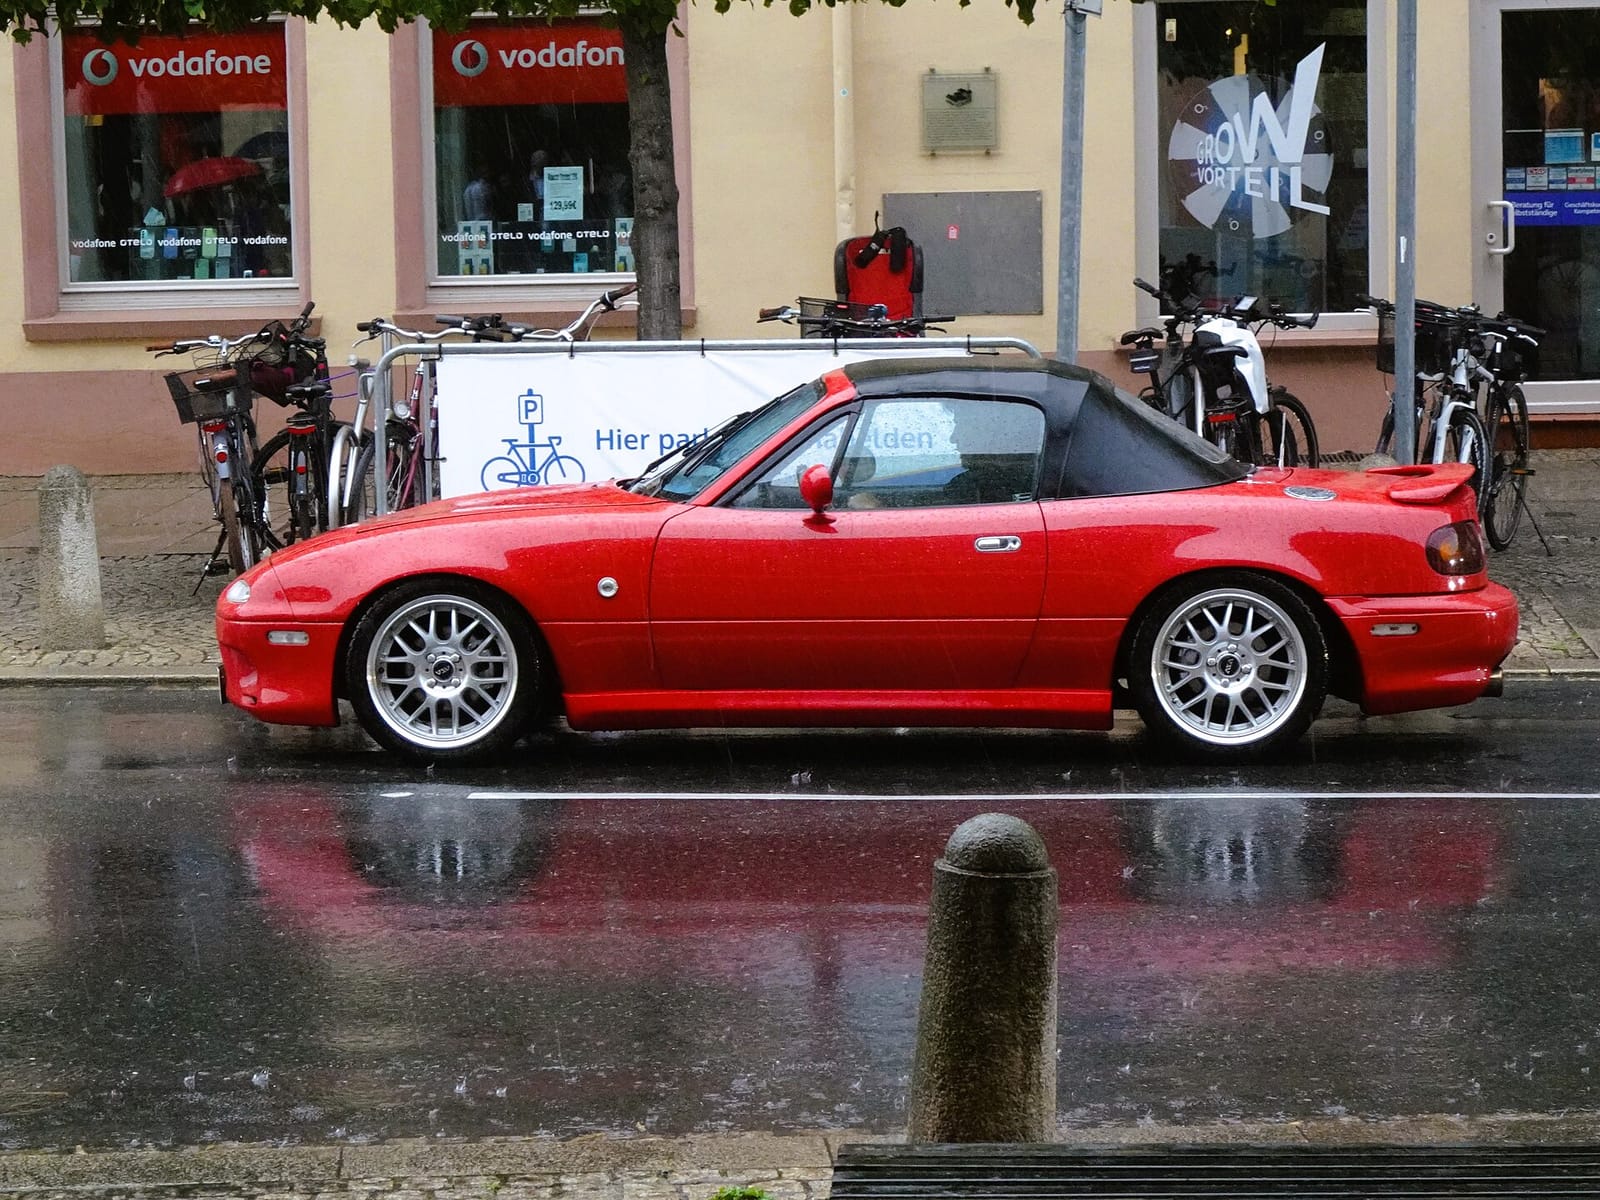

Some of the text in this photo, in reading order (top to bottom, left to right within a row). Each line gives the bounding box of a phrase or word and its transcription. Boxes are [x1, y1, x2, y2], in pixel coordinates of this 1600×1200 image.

[128, 49, 272, 78] vodafone
[498, 40, 625, 69] vodafon
[1196, 41, 1327, 165] GROW
[1196, 166, 1331, 216] VORTEIL
[1544, 200, 1554, 208] für
[72, 238, 117, 248] vodafone
[157, 236, 202, 247] vodafone
[243, 235, 288, 245] vodafone
[441, 233, 487, 243] vodafone
[527, 230, 573, 240] vodafone
[524, 399, 538, 420] P
[596, 429, 650, 450] Hier
